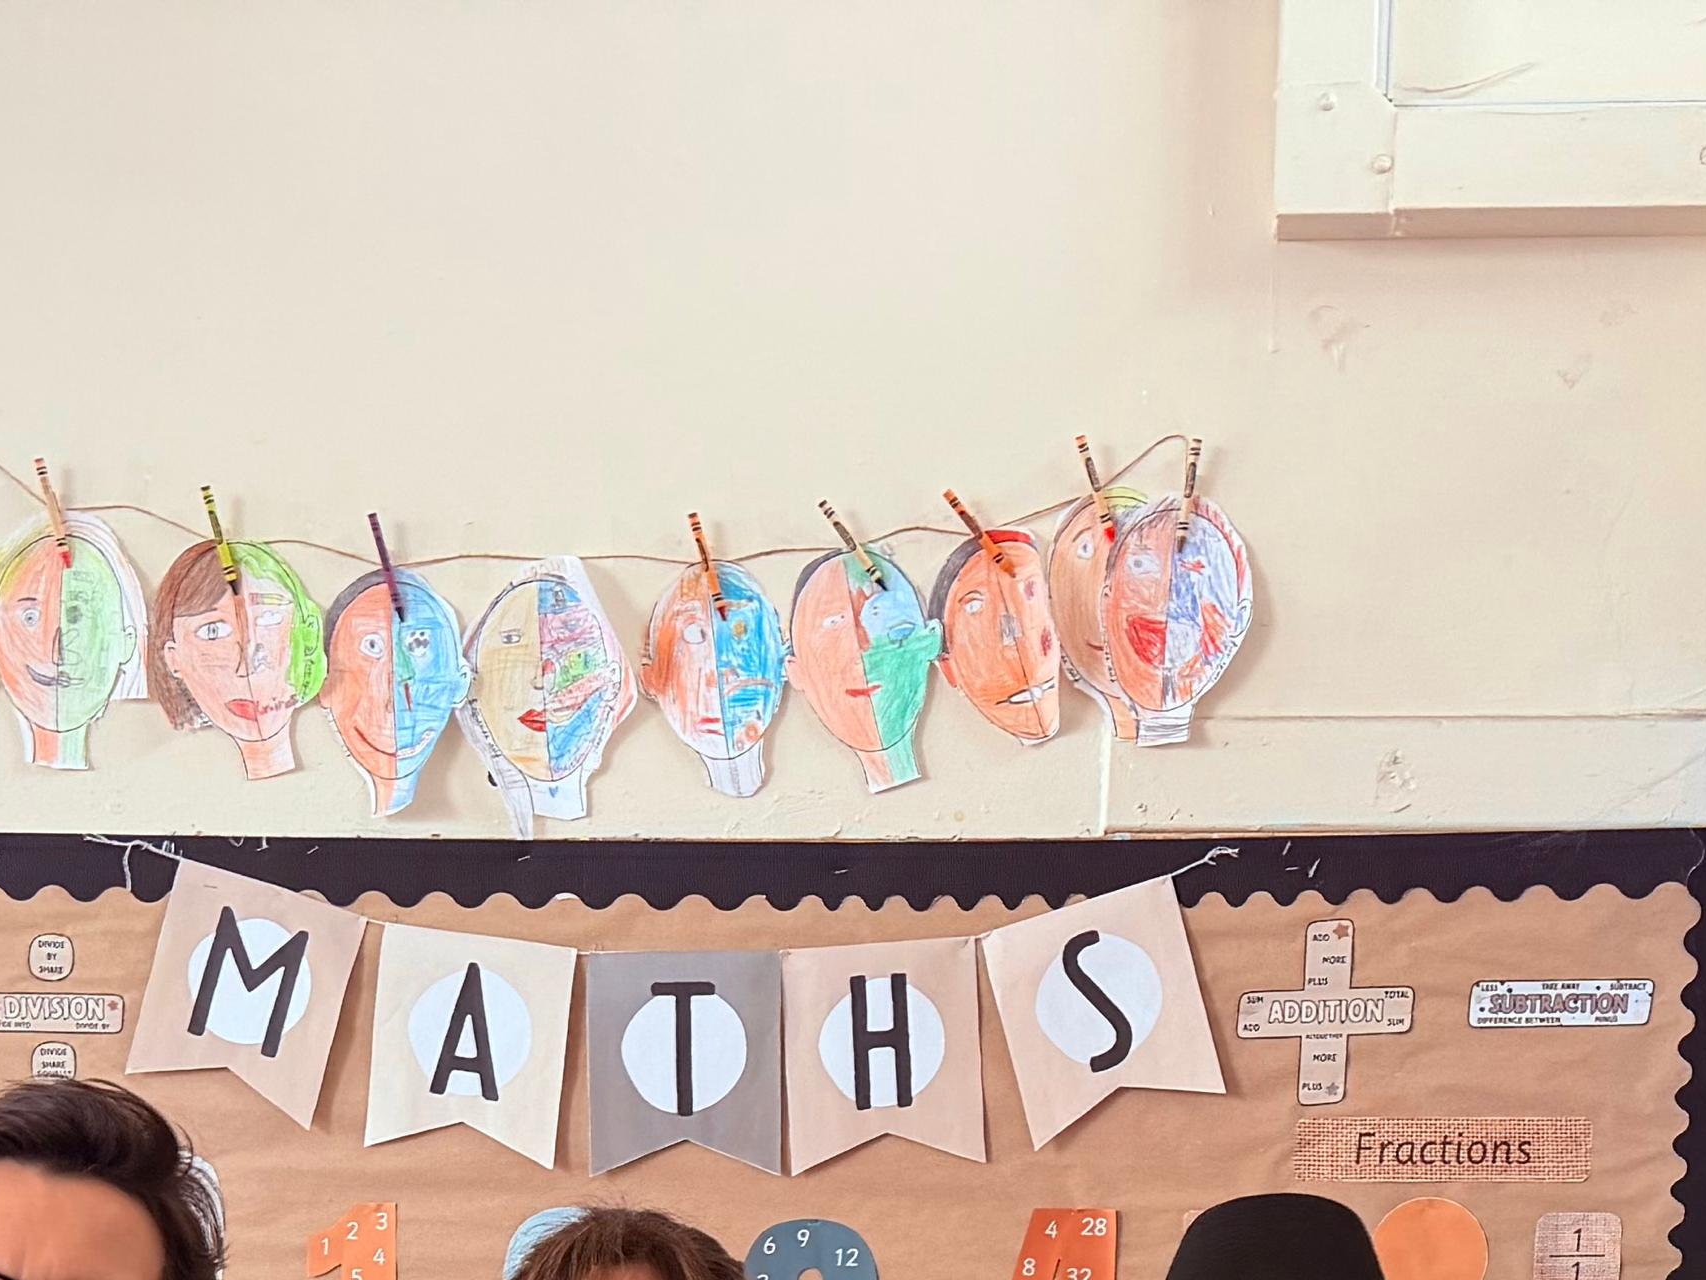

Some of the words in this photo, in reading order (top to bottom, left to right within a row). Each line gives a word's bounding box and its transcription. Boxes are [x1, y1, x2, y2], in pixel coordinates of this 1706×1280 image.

[47, 952, 57, 961] BY
[1322, 956, 1347, 964] MORE
[1308, 978, 1328, 986] PLUS
[1610, 982, 1647, 991] SUBTRACT
[1384, 991, 1410, 999] TOTAL
[1488, 992, 1629, 1016] SUBTRACTION
[3, 995, 106, 1021] DIVISION
[1268, 998, 1385, 1025] ADDITION
[1313, 1054, 1337, 1062] MORE
[1301, 1082, 1323, 1091] PLUS
[1354, 1131, 1533, 1169] Fractions
[346, 1221, 360, 1240] 2
[375, 1212, 388, 1231] 3
[1045, 1220, 1058, 1240] 4
[1081, 1217, 1108, 1237] 28
[322, 1239, 330, 1255] 1
[764, 1237, 776, 1255] 6
[797, 1229, 810, 1248] 9
[1574, 1228, 1582, 1252] 1
[372, 1248, 386, 1266] 4
[835, 1249, 859, 1267] 12
[1022, 1258, 1036, 1277] 8
